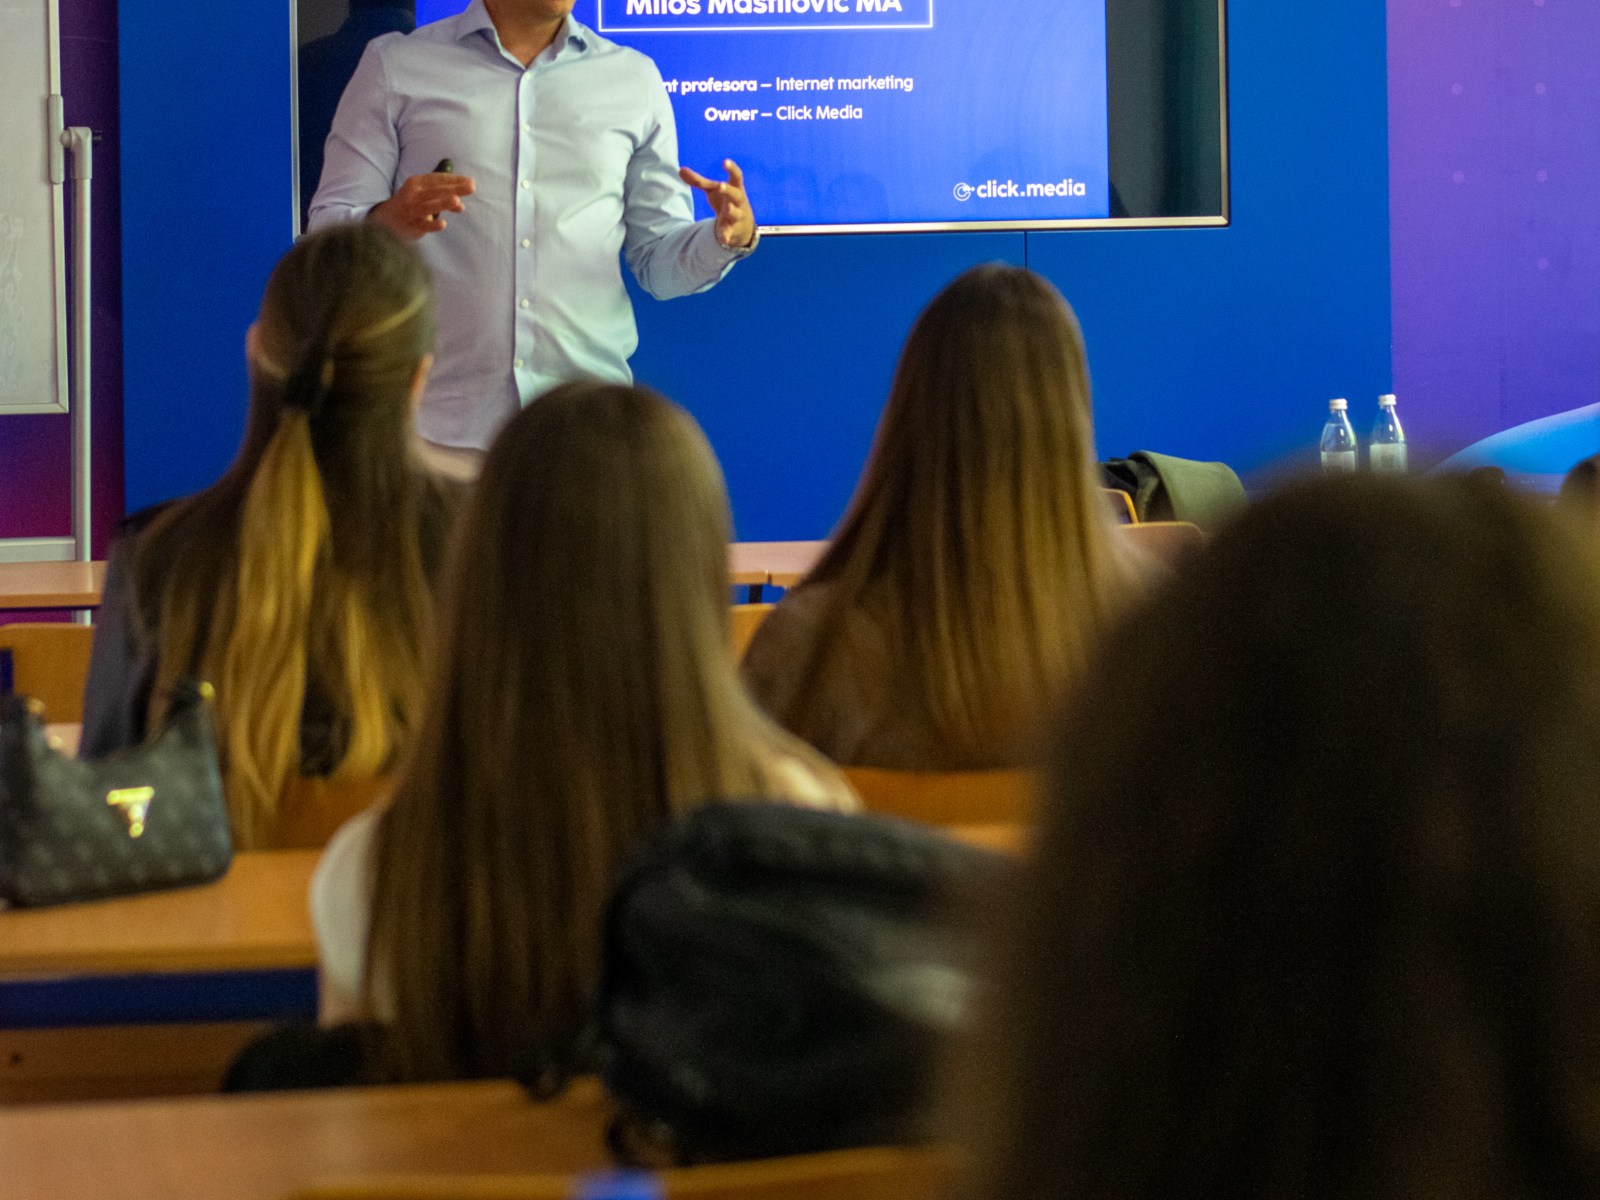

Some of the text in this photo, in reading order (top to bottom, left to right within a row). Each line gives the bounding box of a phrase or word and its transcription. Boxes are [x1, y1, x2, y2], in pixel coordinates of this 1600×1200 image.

[681, 76, 757, 96] profesora
[775, 75, 834, 92] Internet
[837, 73, 914, 93] marketing
[704, 106, 759, 122] Owner
[775, 104, 813, 121] Click
[815, 103, 863, 120] Media
[976, 178, 1086, 198] click.media
